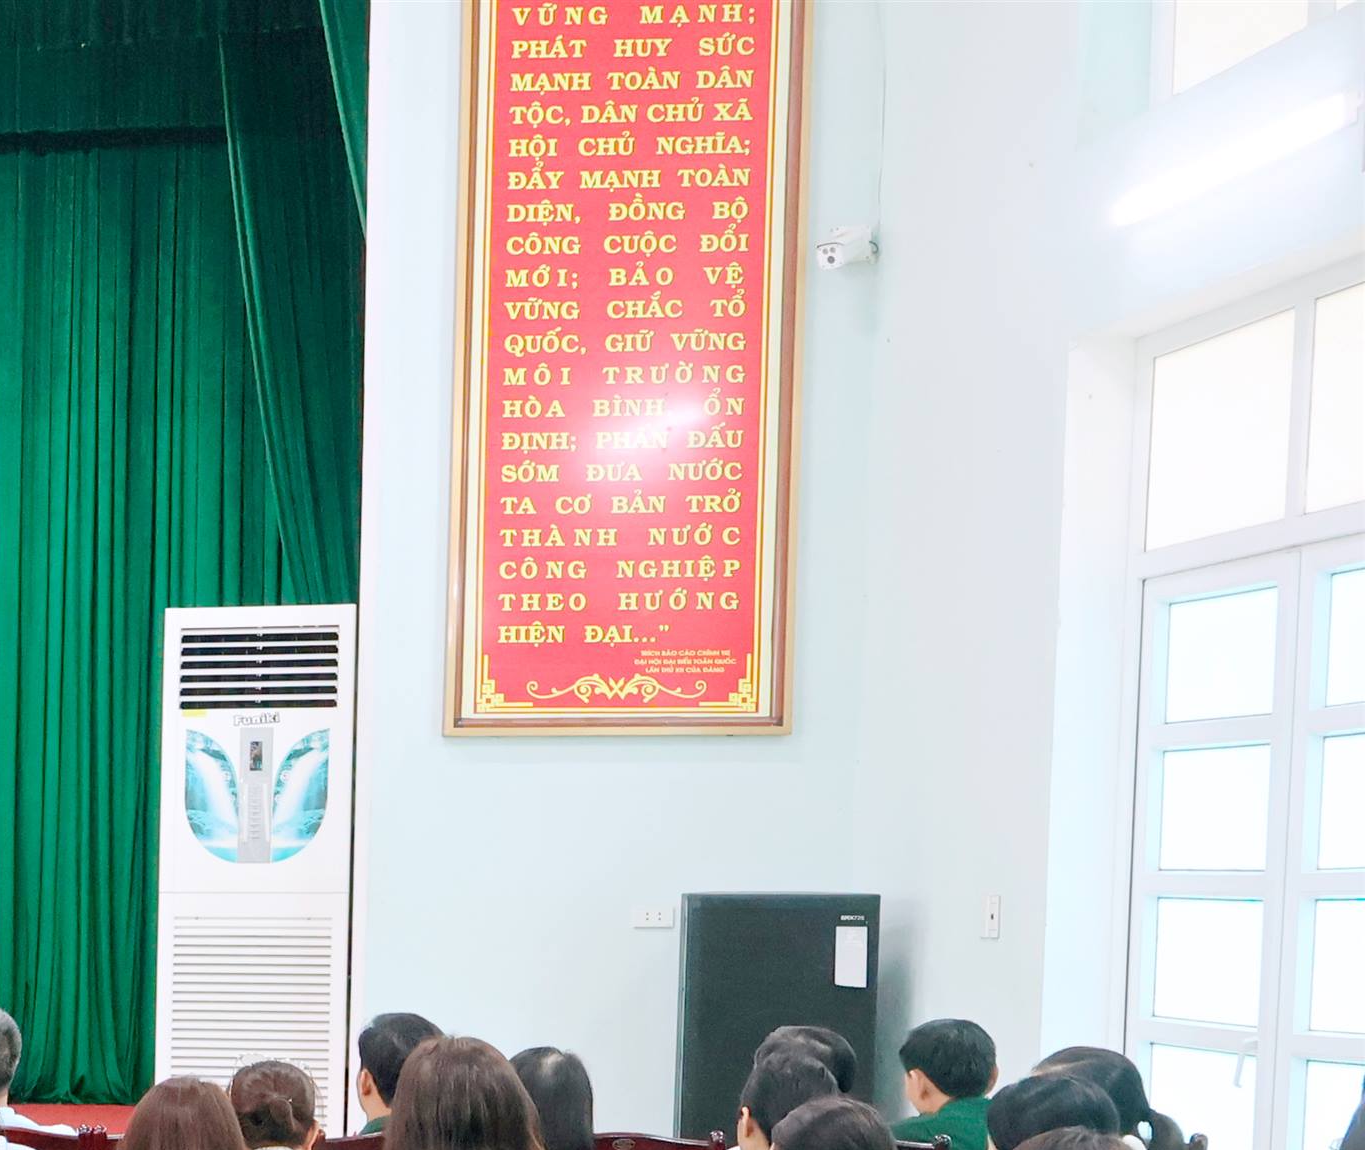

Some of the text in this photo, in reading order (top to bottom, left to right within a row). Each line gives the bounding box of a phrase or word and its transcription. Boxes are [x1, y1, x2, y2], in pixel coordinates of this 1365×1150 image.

[513, 3, 754, 27] VỮNG MẠNH;
[512, 32, 754, 58] PHÁT HUY SỨC
[511, 65, 753, 95] MẠNH TOÀN DÂN
[510, 97, 753, 128] TỘC, DÂN CHỦ XÃ
[509, 131, 750, 162] HỘI CHỦ NGHĨA;
[508, 161, 750, 194] ĐẨY MẠNH TOÀN
[507, 193, 748, 226] DIỆN, ĐỒNG BỘ
[506, 224, 748, 257] CÔNG CUỘC ĐỔI
[506, 261, 743, 288] MỚI; BẢO VỆ
[505, 289, 748, 320] VỮNG CHẮC TỔ
[505, 327, 746, 357] QUỐC, GIỮ VỮNG
[504, 362, 745, 385] MÔI TRƯỜNG
[503, 395, 565, 417] HÒA
[703, 388, 745, 418] ỔN
[502, 432, 576, 453] ĐỊNH;
[686, 422, 743, 448] ĐẤU
[502, 458, 741, 482] SỚM ĐƯA NƯỚC
[501, 488, 741, 514] TA CƠ BẢN TRỞ
[500, 523, 740, 546] THÀNH NƯỚC
[499, 555, 741, 581] CÔNG NGHIỆP
[499, 588, 739, 611] THEO HƯỚNG
[498, 621, 565, 646] HIỆN
